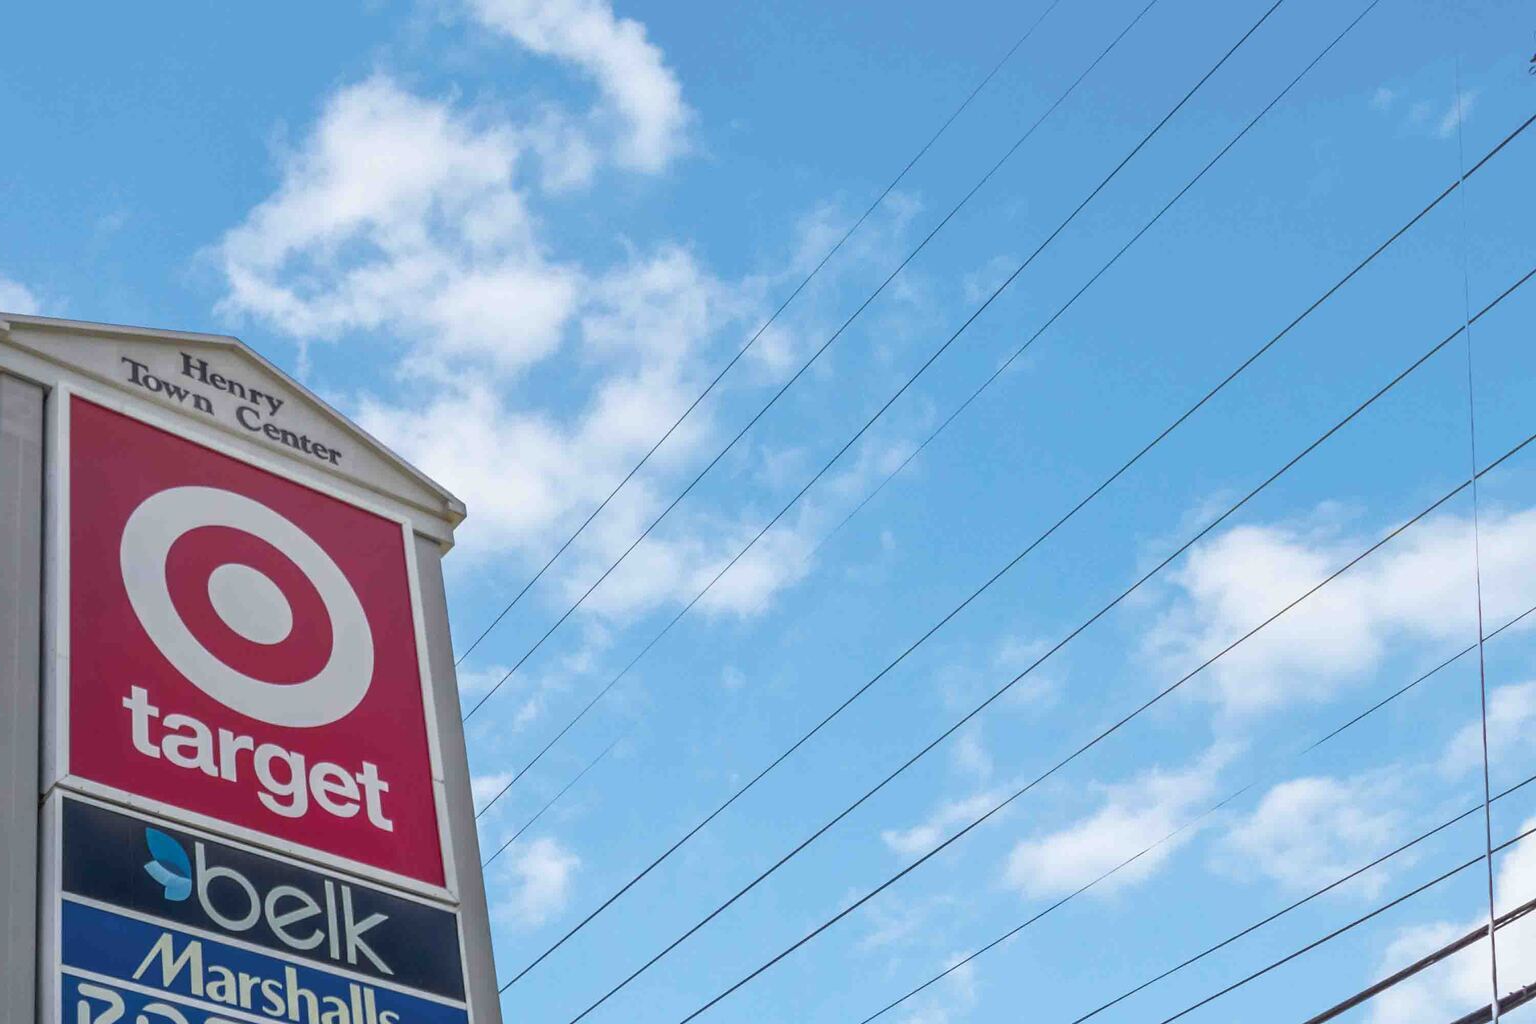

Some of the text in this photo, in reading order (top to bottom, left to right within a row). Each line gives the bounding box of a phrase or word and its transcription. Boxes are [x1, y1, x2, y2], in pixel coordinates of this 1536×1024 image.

[121, 357, 342, 465] Town Center
[179, 352, 284, 415] Henry
[122, 685, 394, 832] target
[194, 842, 394, 975] belk
